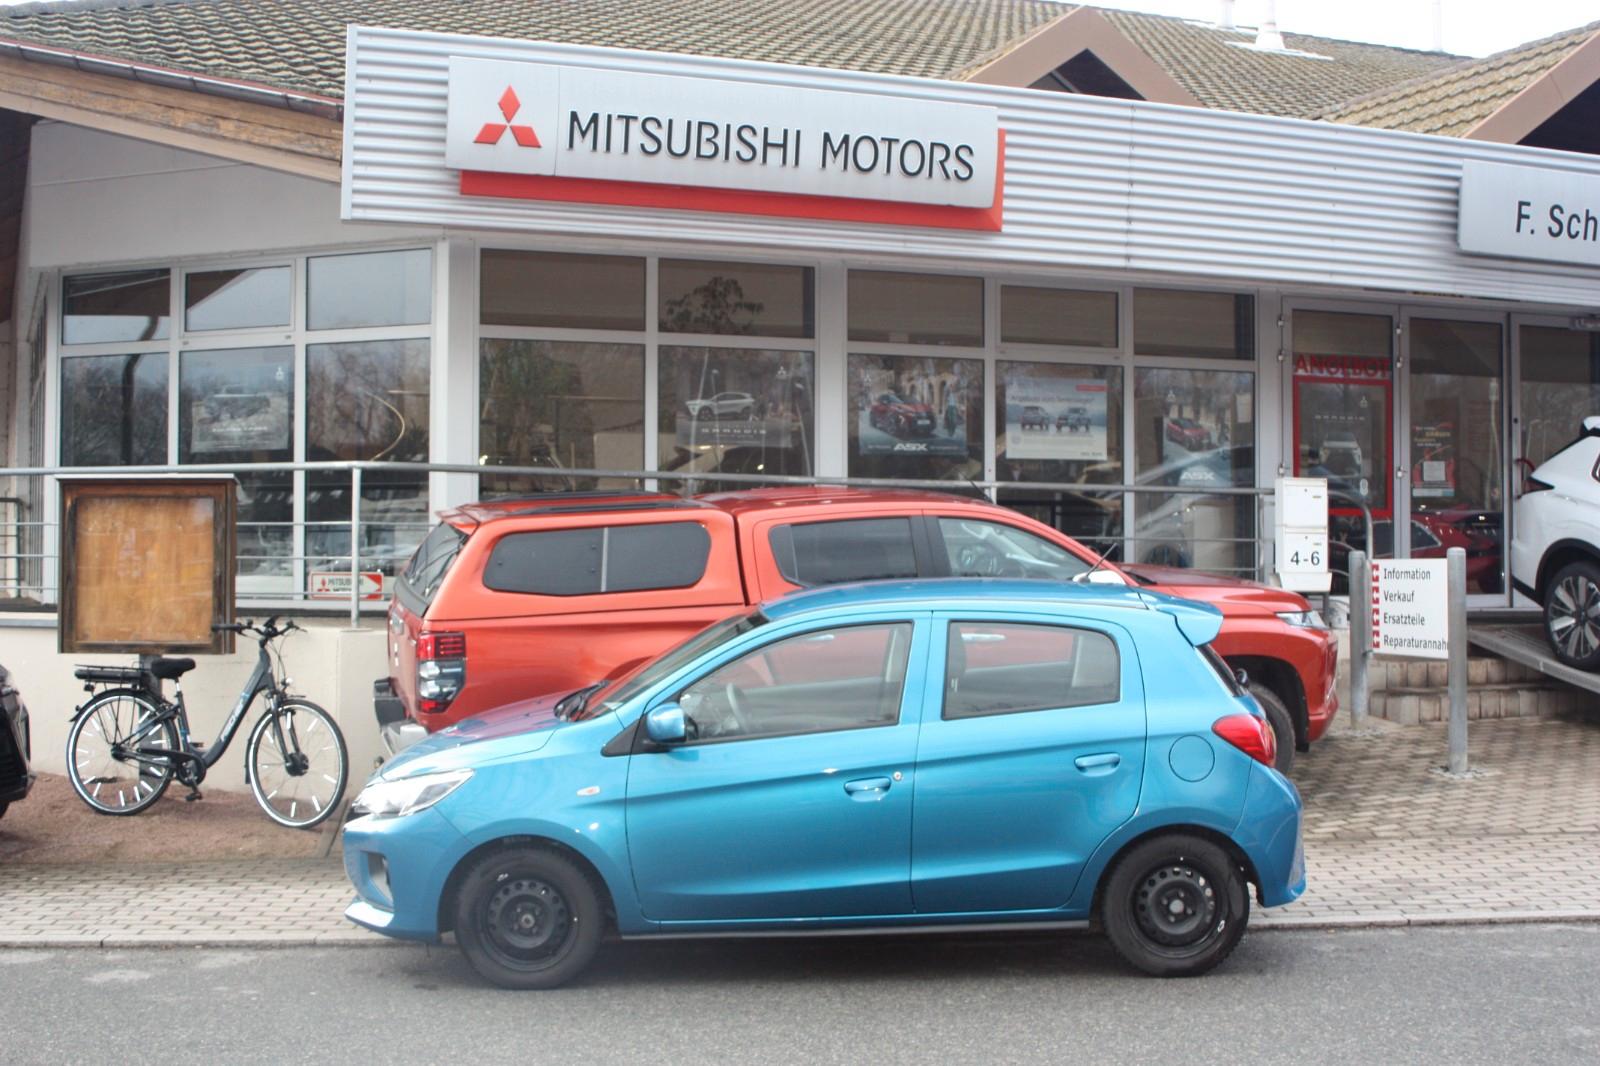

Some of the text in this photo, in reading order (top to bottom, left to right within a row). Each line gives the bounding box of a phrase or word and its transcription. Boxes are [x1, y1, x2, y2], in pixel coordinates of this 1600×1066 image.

[567, 109, 975, 182] MITSUBISHI MOTORS
[1515, 200, 1600, 242] F. Sch
[893, 443, 929, 451] ASX
[1180, 471, 1216, 481] ASX
[1383, 568, 1431, 580] Information
[1383, 590, 1415, 602] Verkauf
[1383, 612, 1425, 626] Ersatzteile
